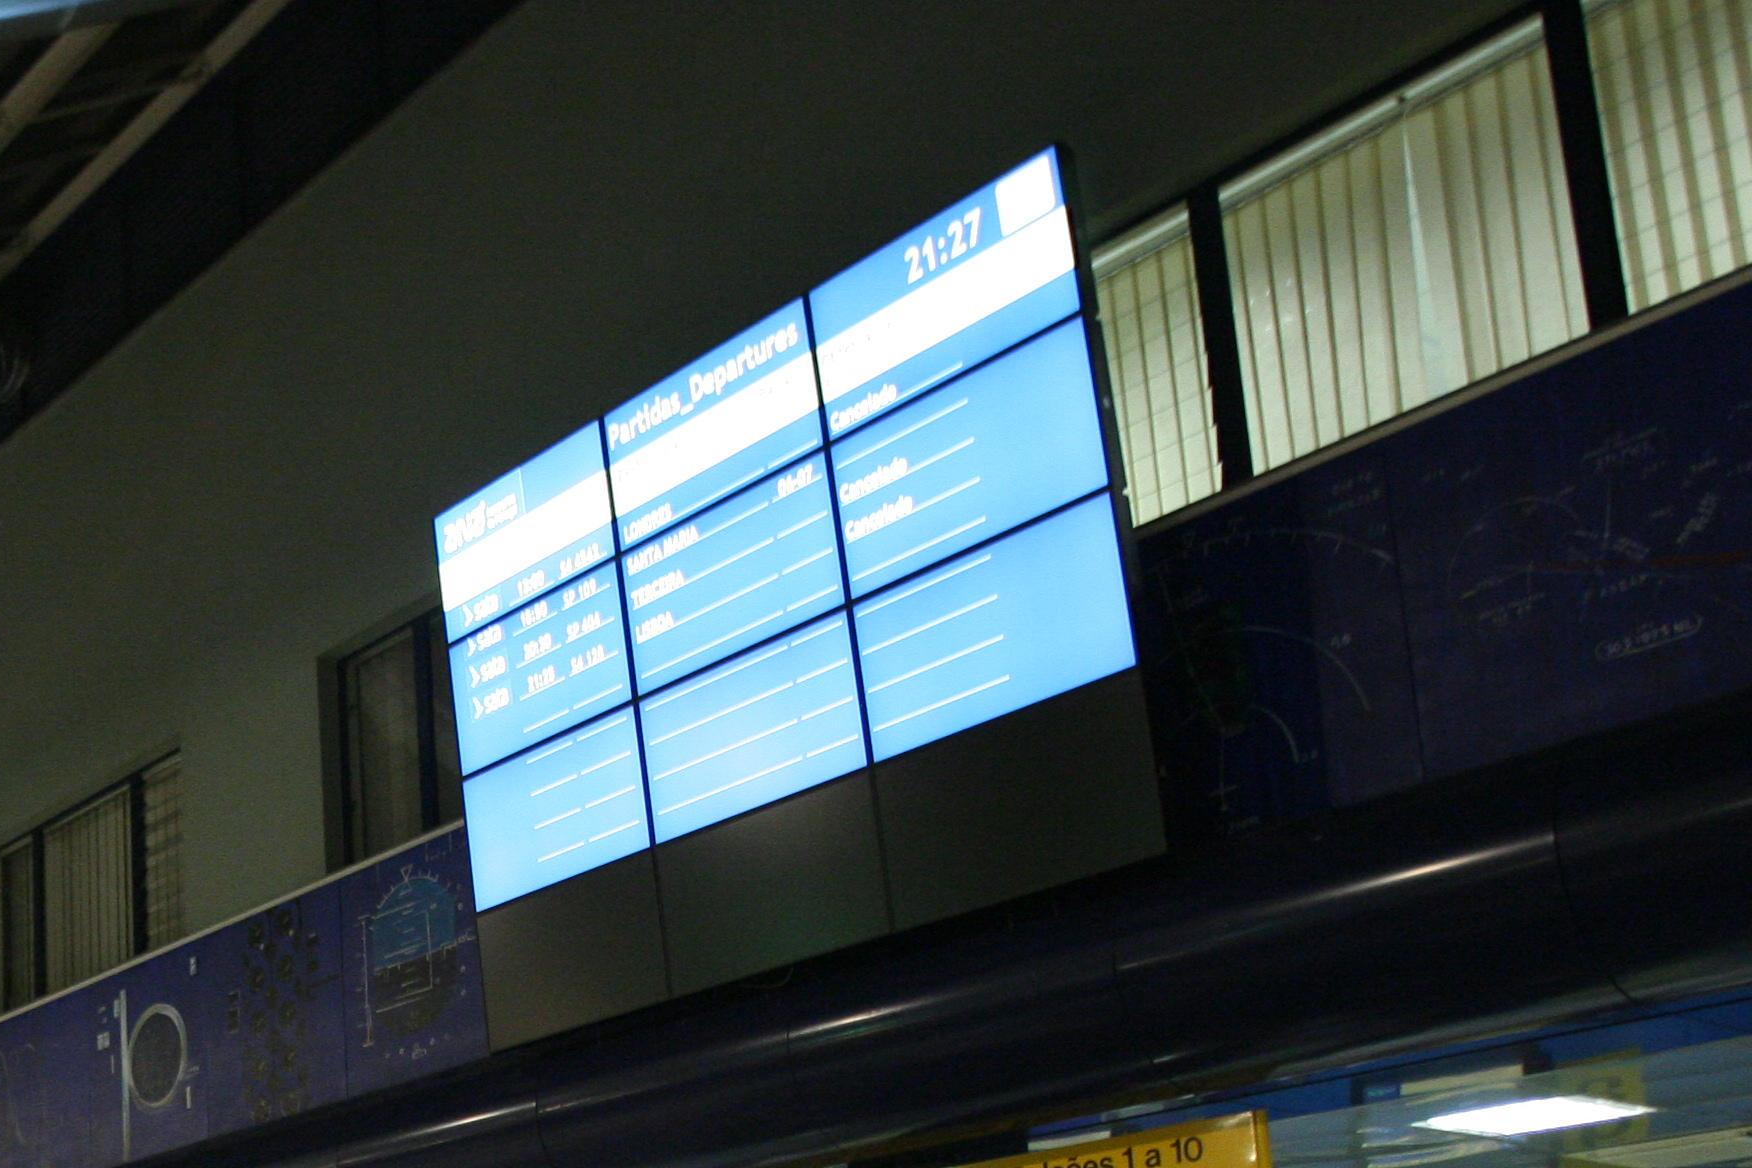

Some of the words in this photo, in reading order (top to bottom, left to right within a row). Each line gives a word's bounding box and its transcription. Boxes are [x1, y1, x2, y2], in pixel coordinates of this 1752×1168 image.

[904, 207, 981, 284] 21:27
[830, 383, 897, 431] Cancelado
[839, 457, 908, 503] Cancelado
[845, 495, 913, 541] Cancelado
[627, 543, 664, 577] SANTA
[663, 524, 699, 559] MARIA
[1145, 1149, 1162, 1168] a
[1169, 1136, 1203, 1163] 10
